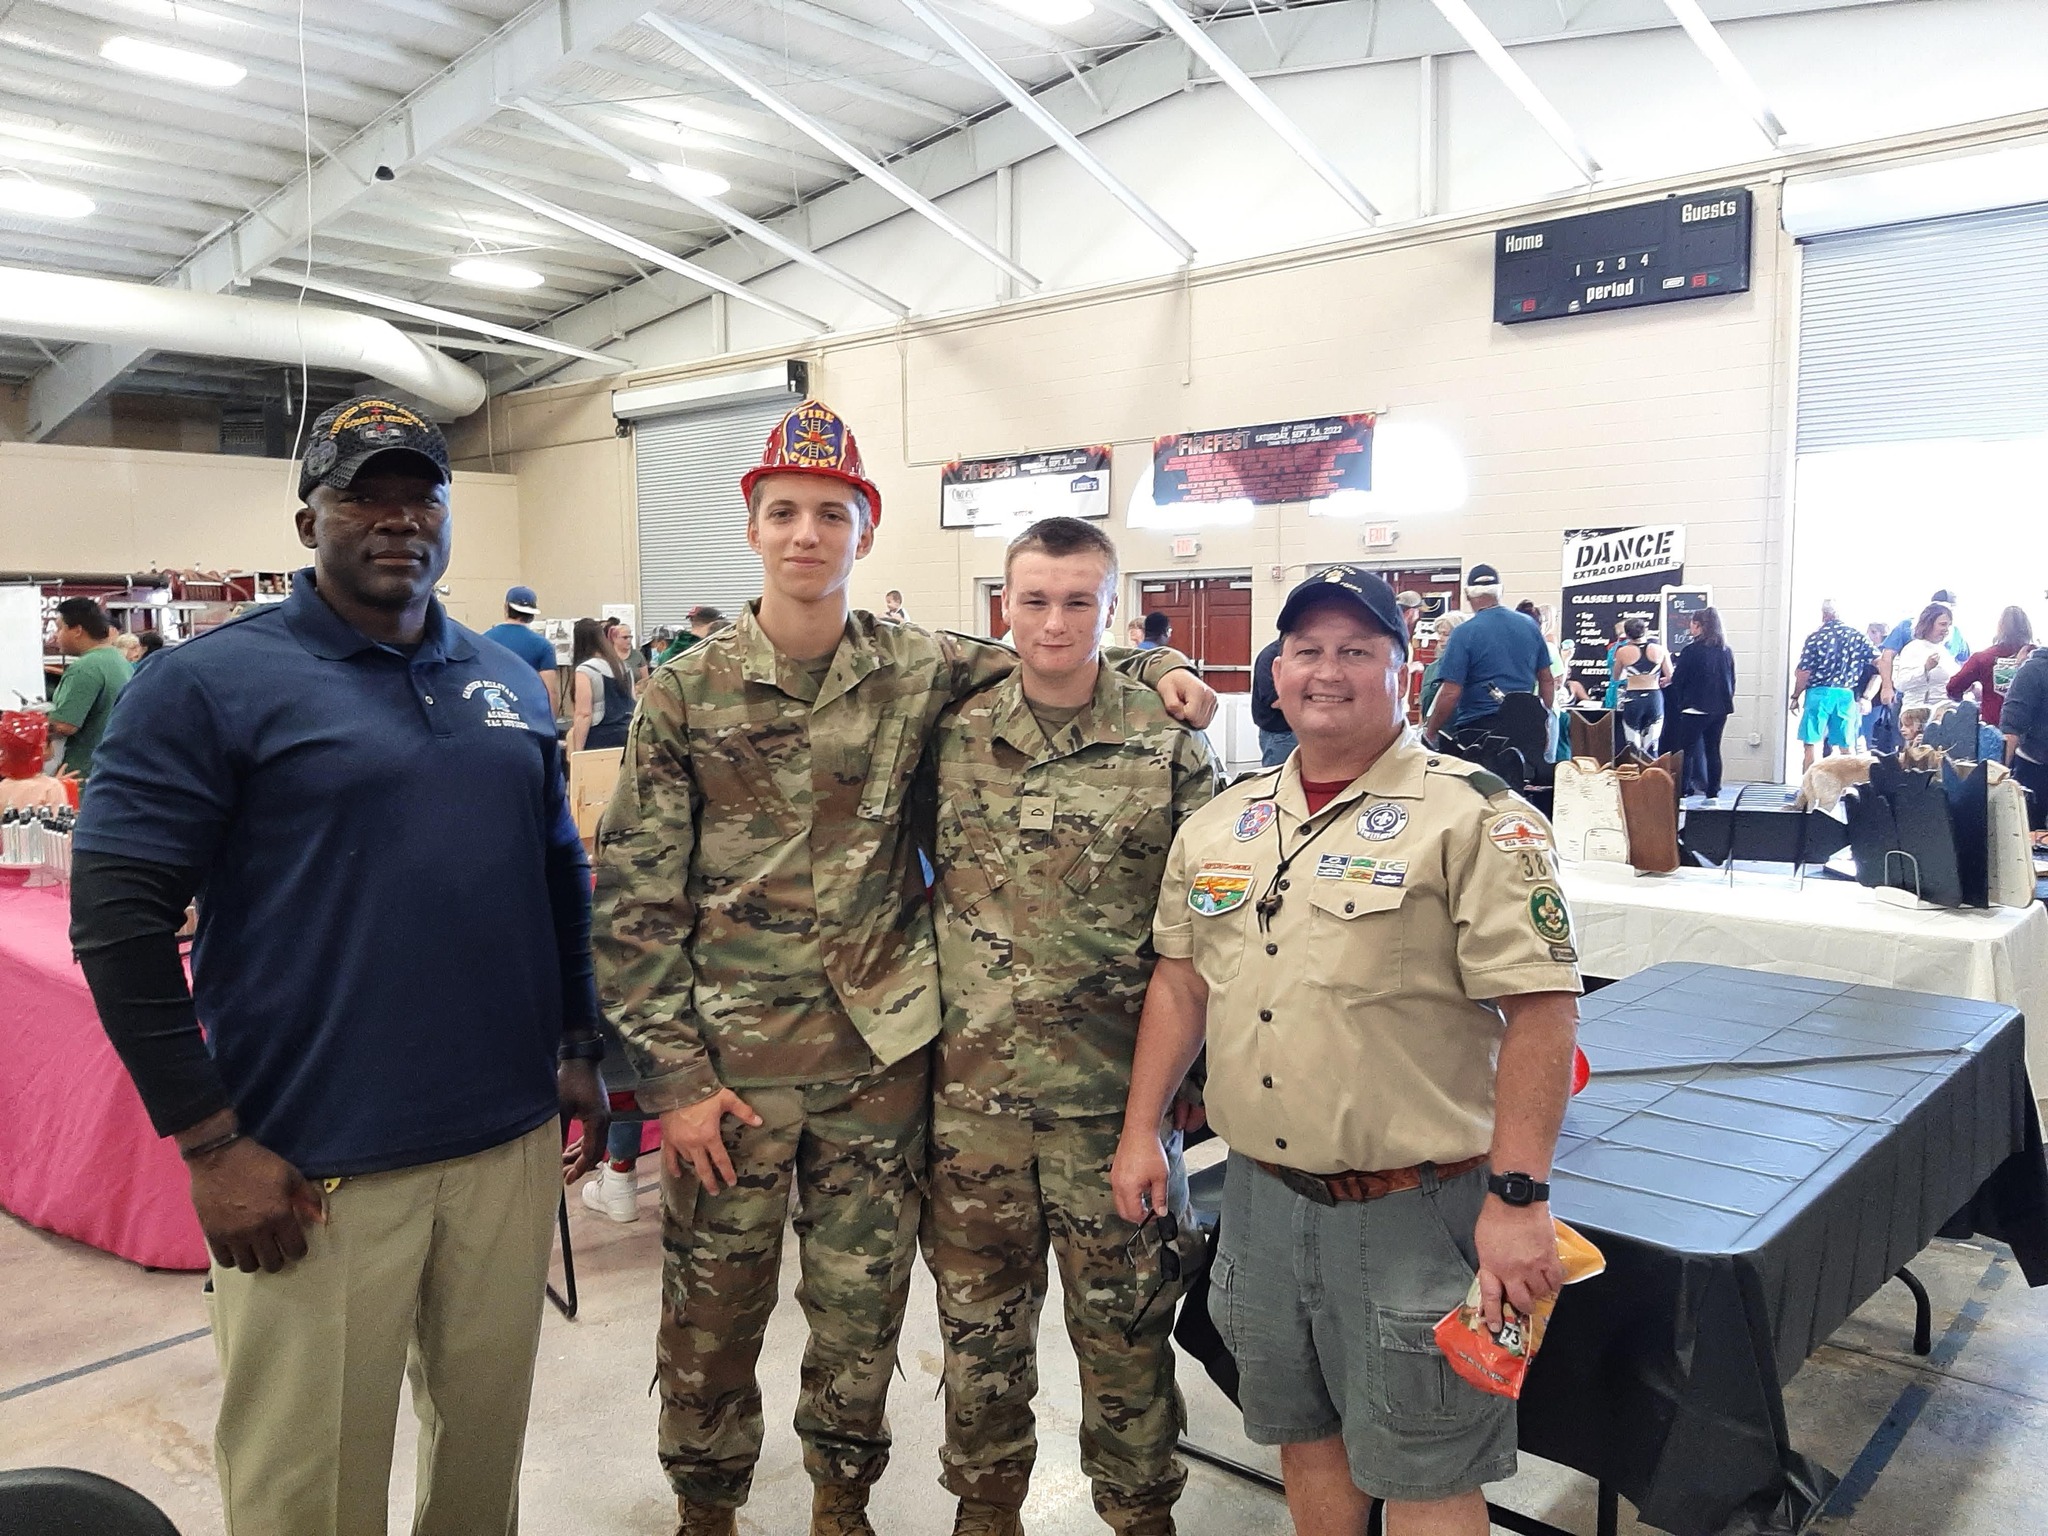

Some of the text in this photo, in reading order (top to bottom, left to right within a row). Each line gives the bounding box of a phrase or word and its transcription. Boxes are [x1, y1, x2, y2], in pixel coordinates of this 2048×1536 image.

[1681, 200, 1737, 223] Guests
[1505, 233, 1543, 253] Home
[1575, 253, 1650, 277] 1 2 3 4
[1586, 278, 1634, 304] period
[798, 409, 835, 423] FIRE
[1323, 426, 1343, 435] 2022
[1177, 431, 1250, 456] FIREFEST
[789, 452, 838, 468] CHIEF
[1575, 530, 1675, 568] DANCE
[1573, 556, 1671, 580] EXTRAORDINAIRE
[1571, 593, 1662, 604] CLASSES WE OFFE
[1521, 853, 1547, 877] 38
